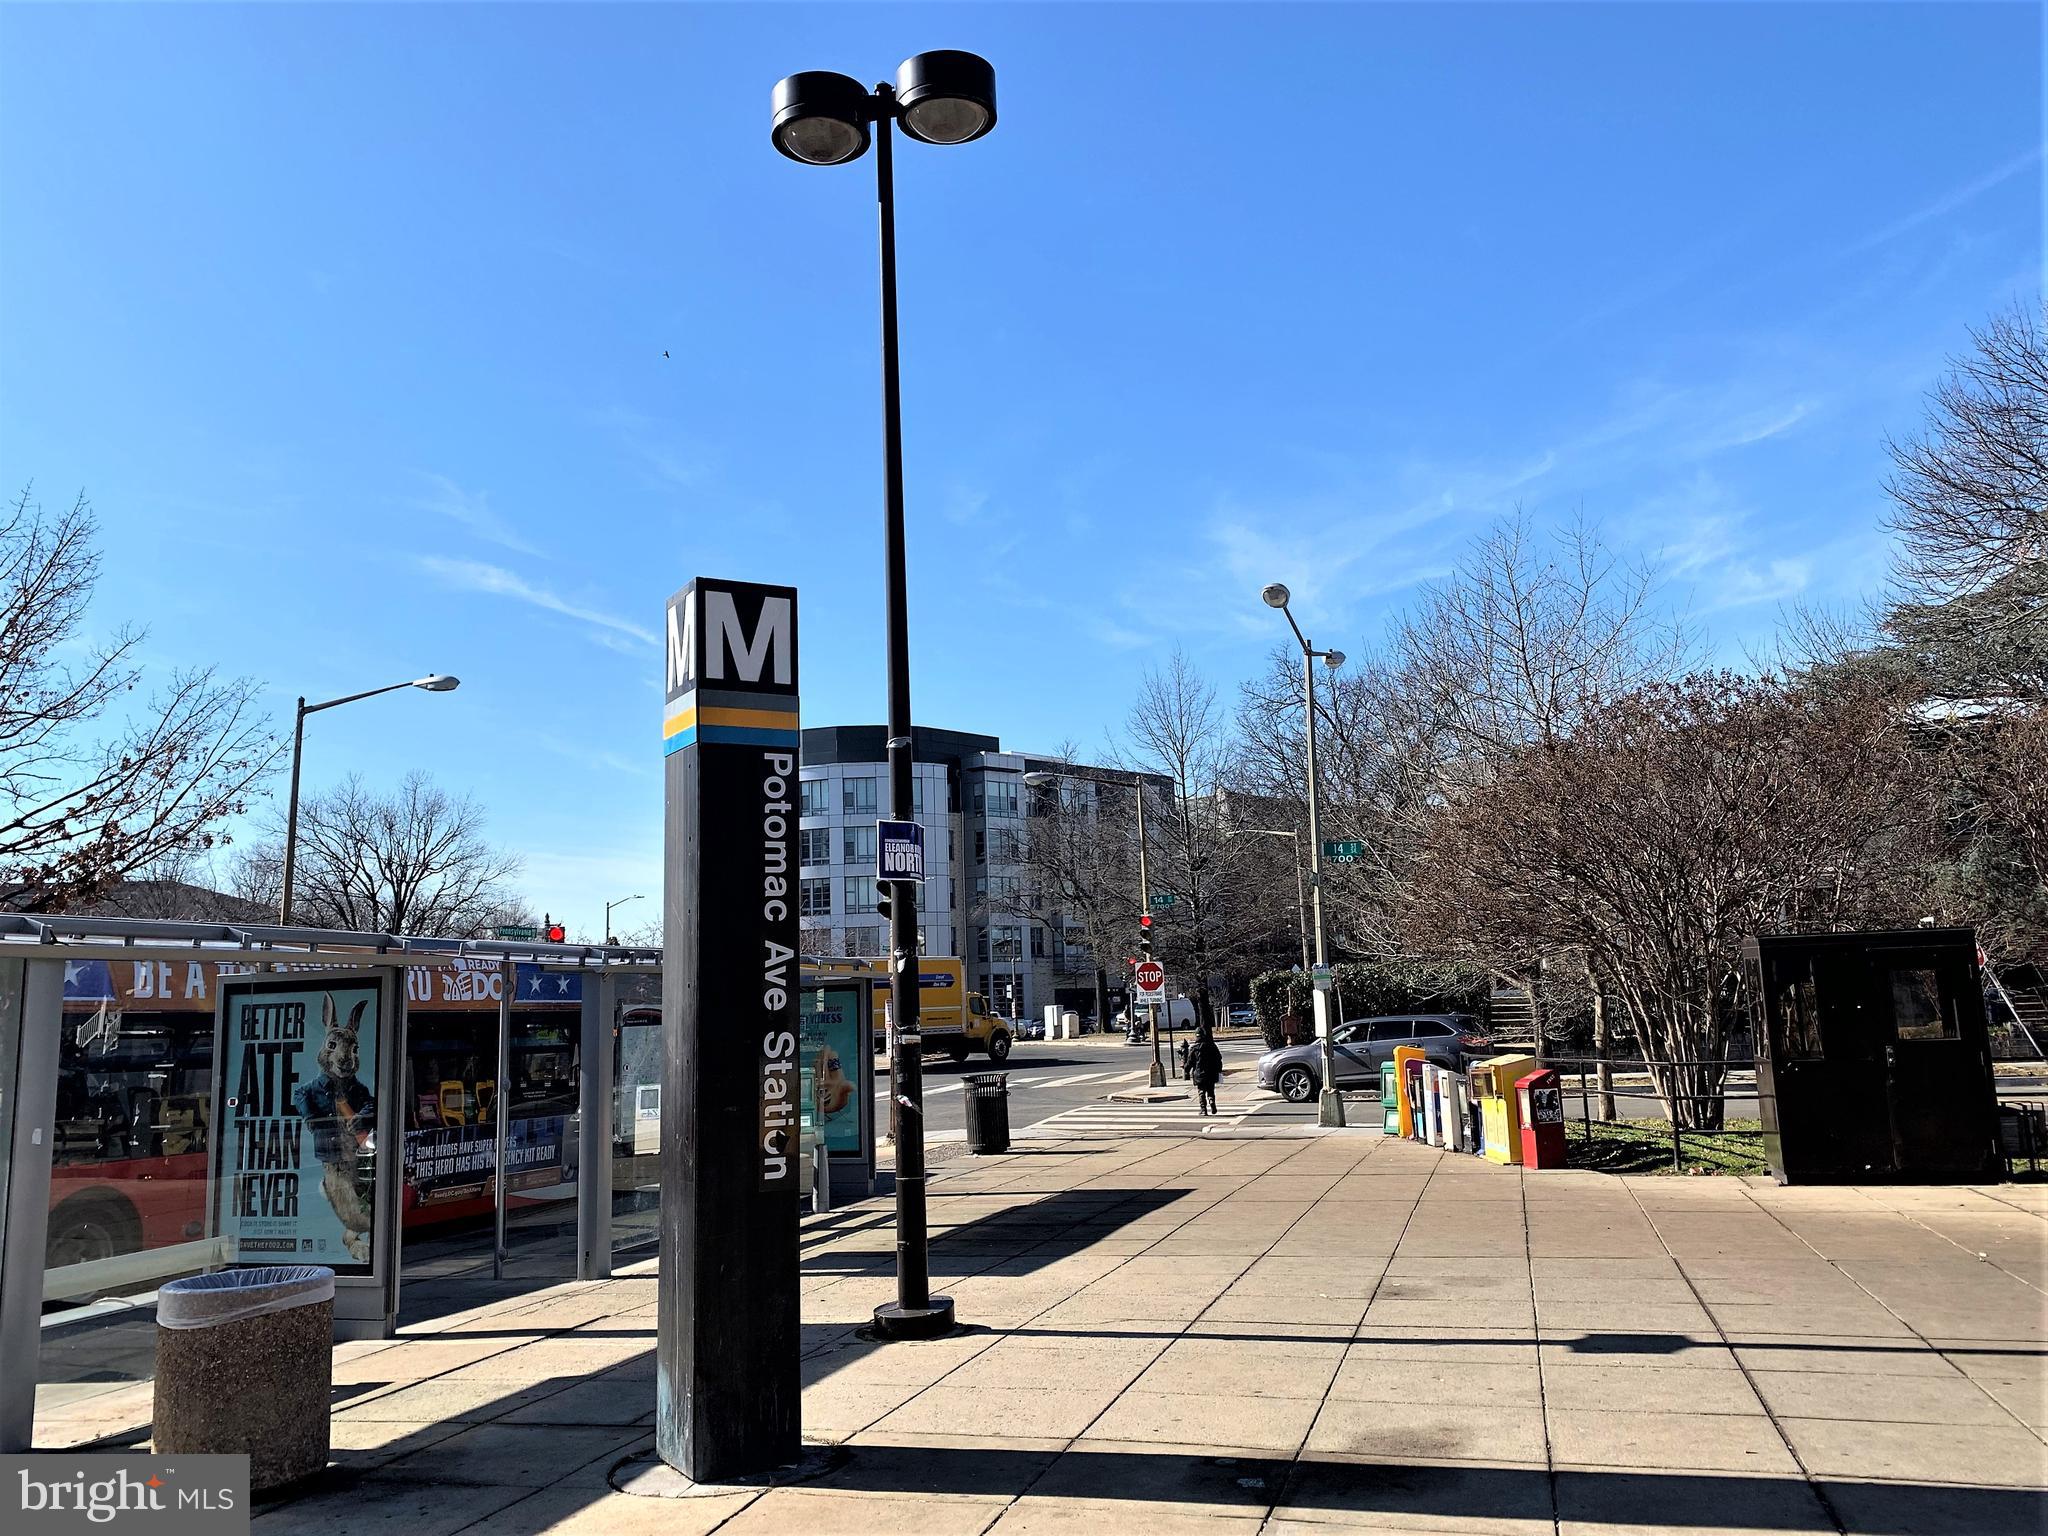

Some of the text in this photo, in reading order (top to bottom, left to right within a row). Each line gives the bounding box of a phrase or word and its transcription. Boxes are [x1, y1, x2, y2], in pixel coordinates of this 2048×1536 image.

[667, 590, 695, 694] M
[705, 590, 791, 685] M
[884, 843, 914, 853] ELEANOR
[1332, 855, 1353, 863] 700
[1334, 843, 1343, 854] 14
[1153, 896, 1163, 904] 14
[184, 961, 206, 999] A
[468, 960, 500, 971] READY
[763, 752, 795, 1181] Potomac Ave Station
[1138, 971, 1162, 983] STOP
[241, 1002, 306, 1041] BETTER
[235, 1042, 304, 1117] ATE
[234, 1119, 302, 1170] THAN
[416, 1146, 434, 1159] SOME
[435, 1143, 458, 1157] HEROES
[459, 1141, 474, 1154] HAVE
[474, 1139, 493, 1152] SUPER
[416, 1160, 434, 1178] THIS
[434, 1158, 455, 1176] HERO
[455, 1156, 471, 1173] HAS
[471, 1154, 485, 1170] HIS
[525, 1148, 536, 1163] KIT
[536, 1144, 556, 1161] READY
[232, 1172, 299, 1217] NEVER
